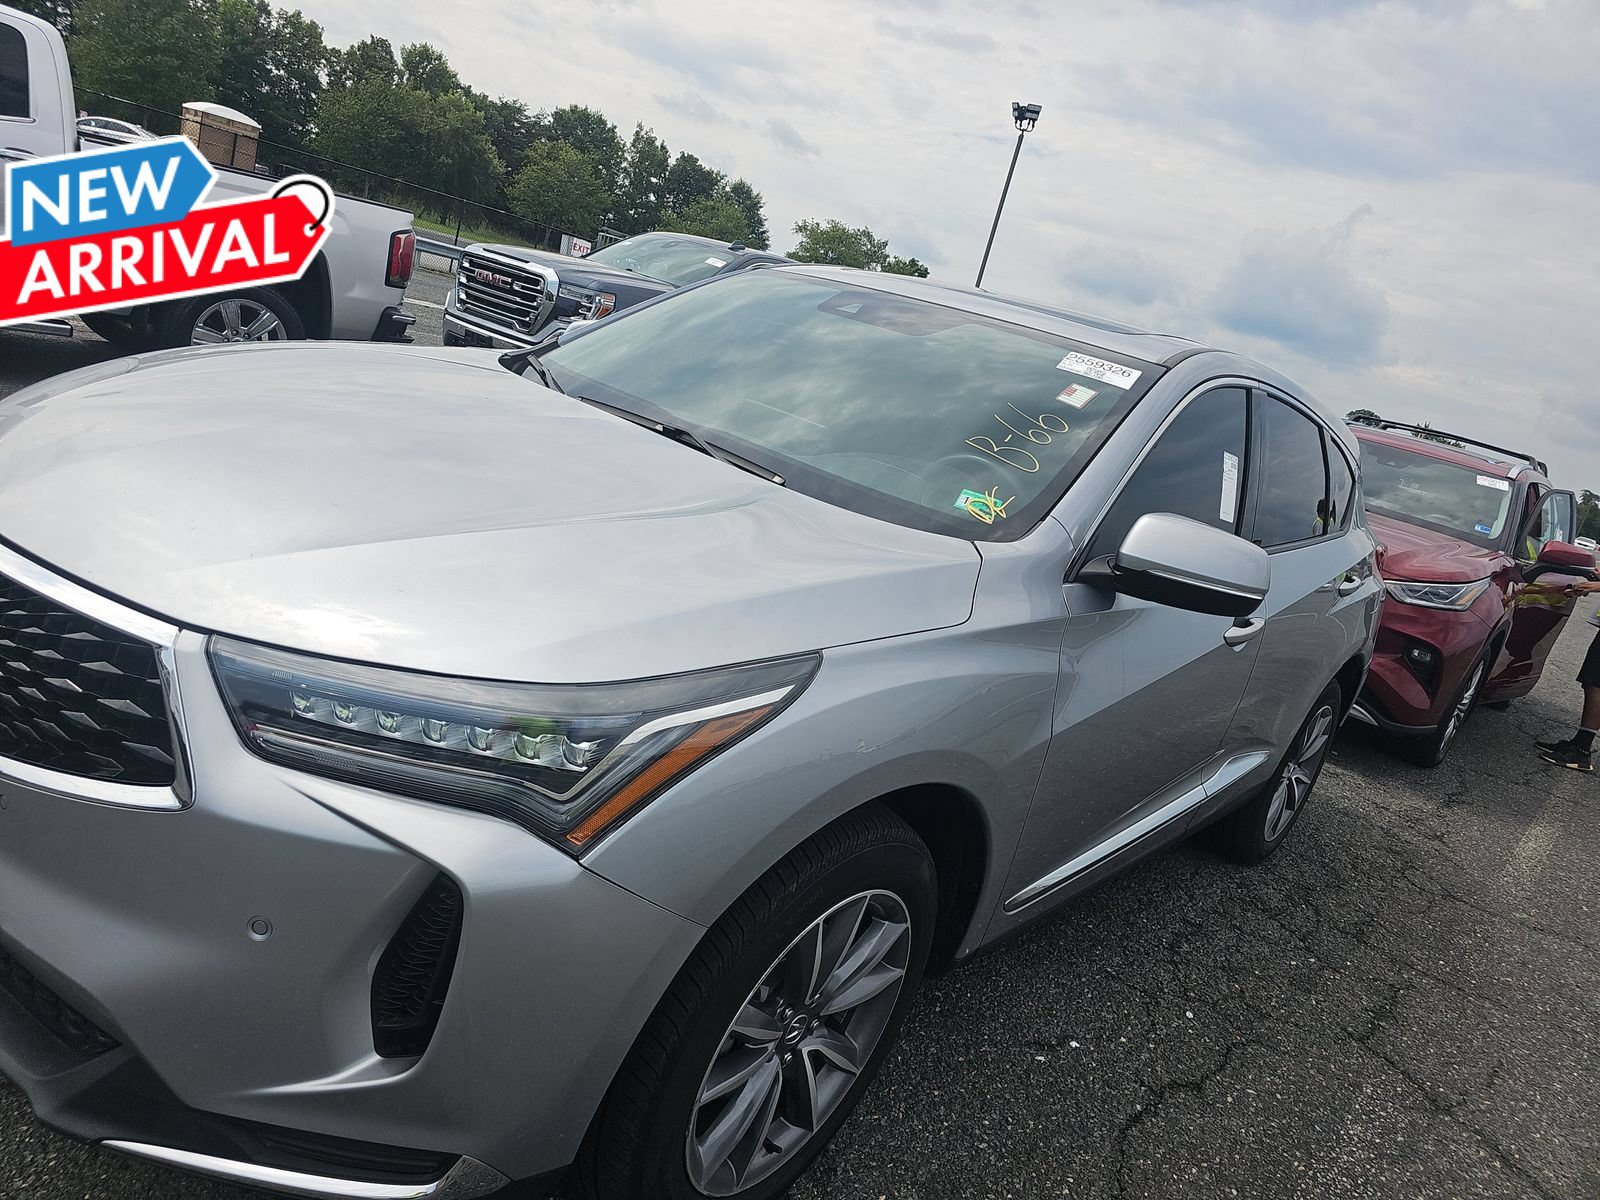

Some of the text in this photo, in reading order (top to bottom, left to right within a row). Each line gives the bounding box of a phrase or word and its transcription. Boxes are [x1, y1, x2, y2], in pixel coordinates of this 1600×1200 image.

[572, 242, 590, 254] EXIT
[474, 268, 512, 288] GMC
[1065, 353, 1133, 378] 2559326
[965, 402, 1069, 473] B-66
